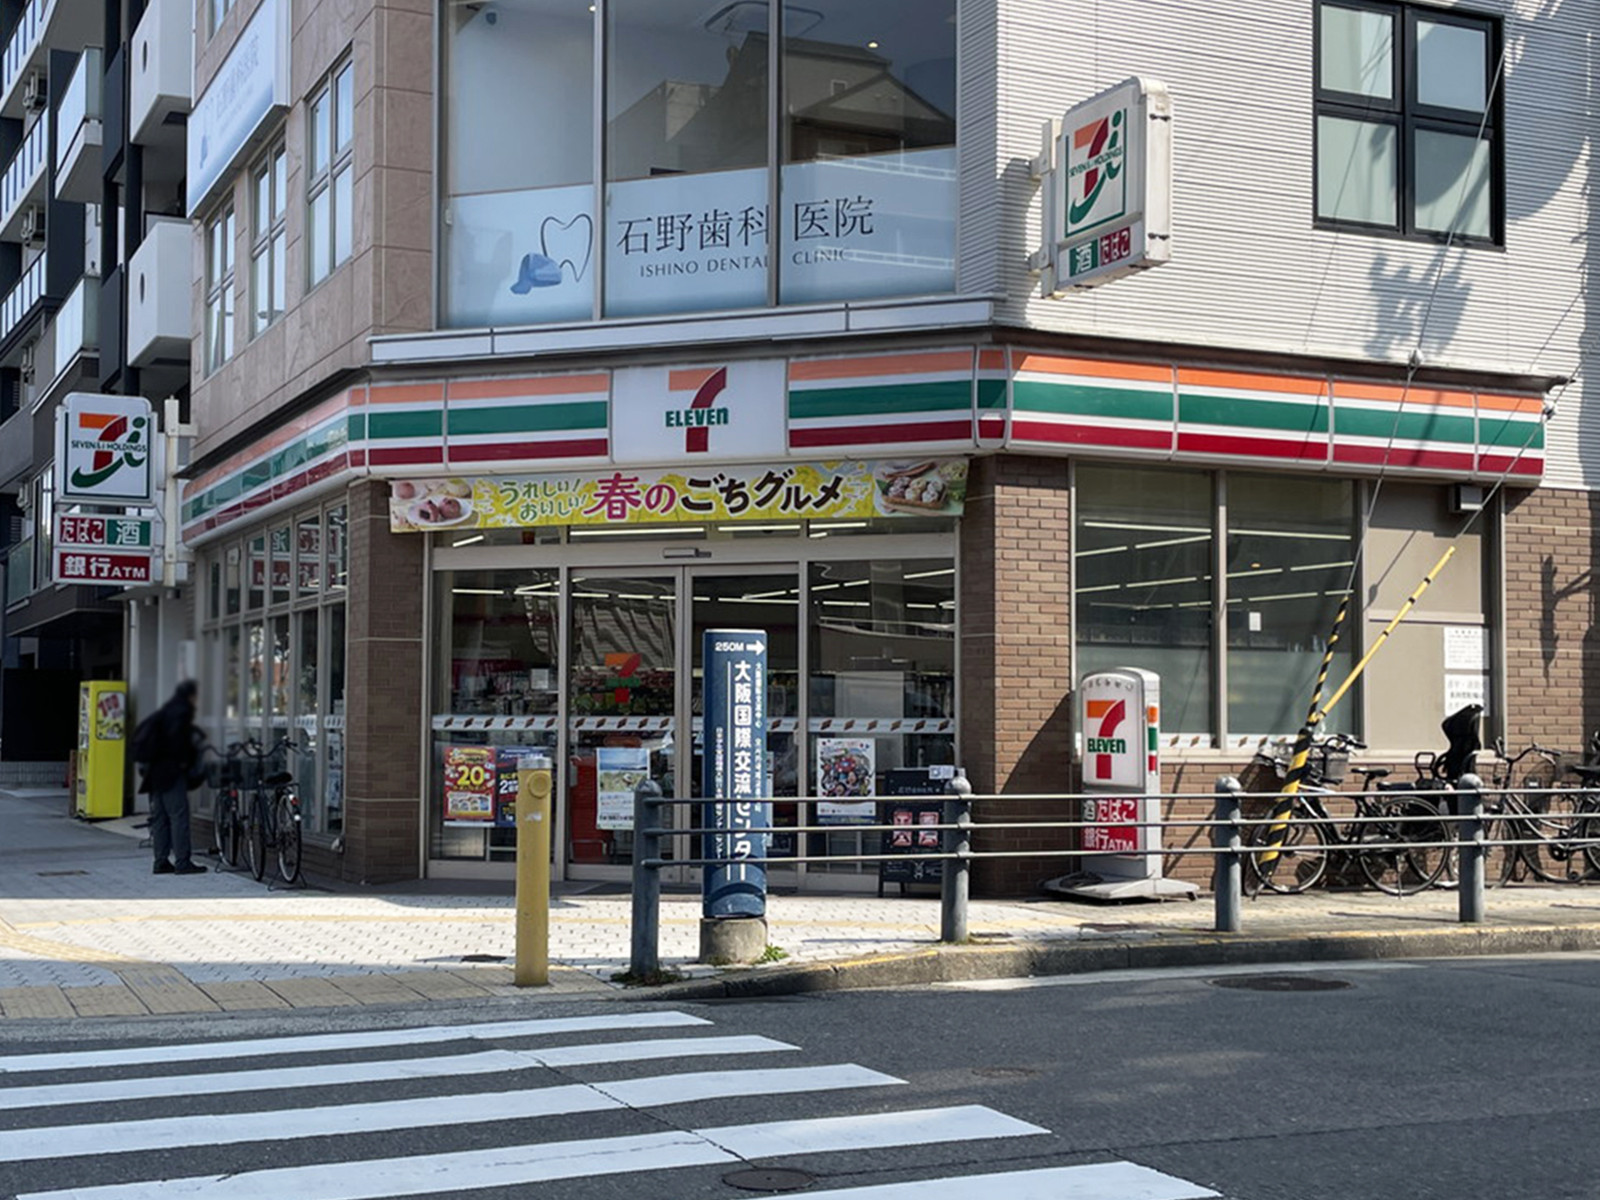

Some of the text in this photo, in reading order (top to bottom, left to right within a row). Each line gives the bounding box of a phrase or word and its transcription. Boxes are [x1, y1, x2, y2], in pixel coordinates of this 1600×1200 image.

[1075, 230, 1130, 273] 酒 たばこ
[640, 260, 699, 278] ISHINO
[107, 442, 147, 452] HOLDINGS
[583, 469, 842, 520] 春のごちグルメ
[62, 520, 141, 544] たばこ 酒
[64, 555, 146, 578] 銀行ATM
[714, 642, 745, 652] 250M
[734, 660, 752, 881] 大阪国際交流センター
[1097, 799, 1135, 822] たばこ
